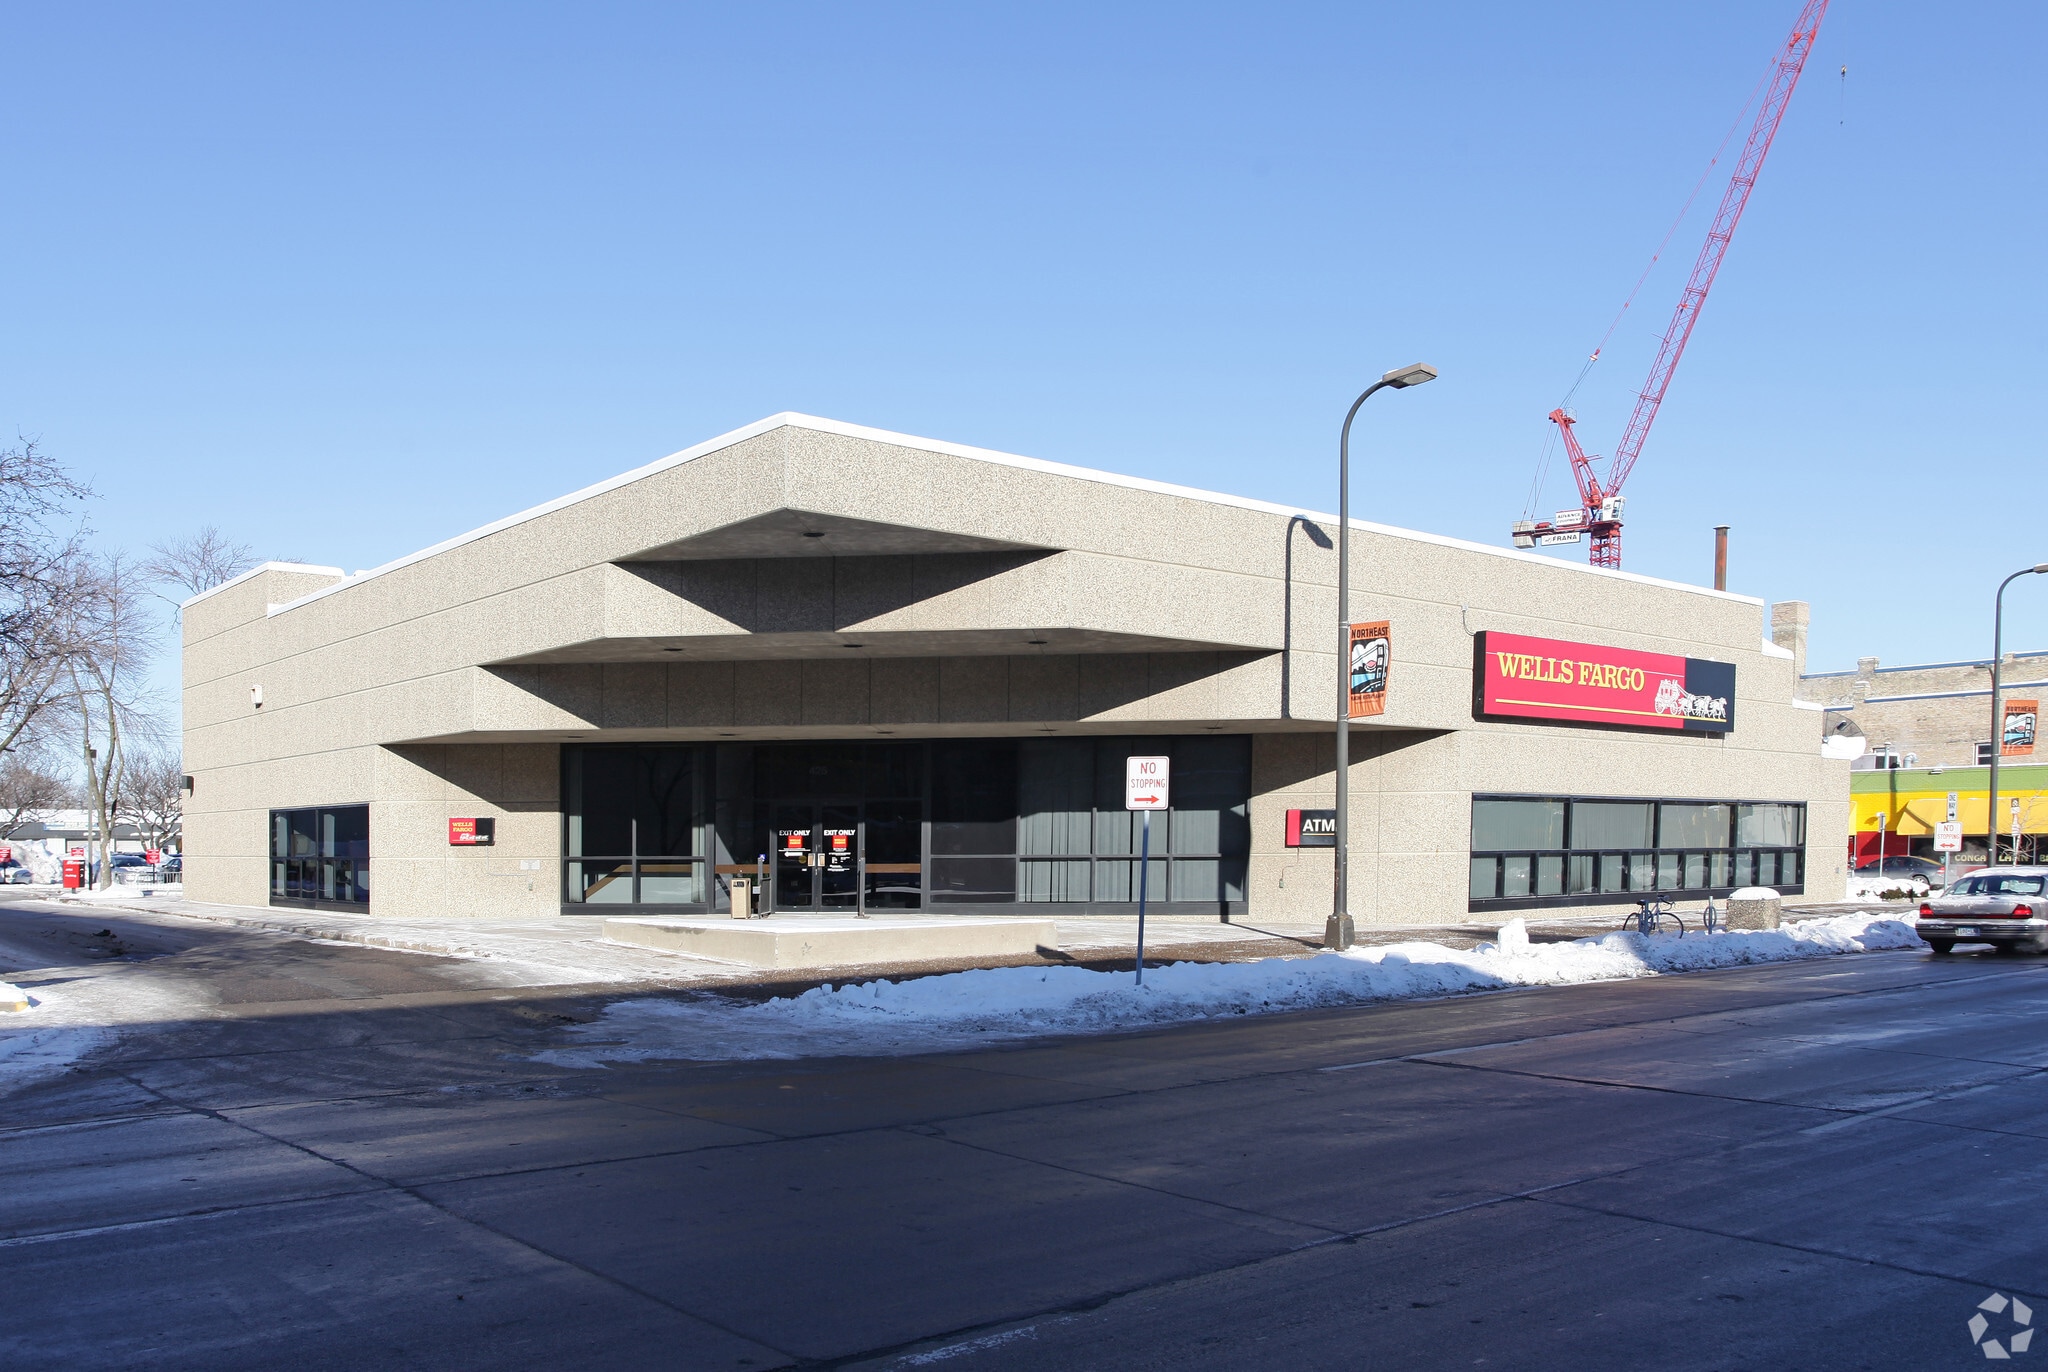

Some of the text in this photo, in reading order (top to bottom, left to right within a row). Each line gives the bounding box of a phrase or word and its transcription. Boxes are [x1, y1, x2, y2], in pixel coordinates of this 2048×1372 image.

[1552, 534, 1578, 542] FRANA
[1351, 626, 1389, 639] NORTHEAST
[1496, 651, 1645, 692] WELLS FARGO
[1140, 762, 1157, 775] NO
[1130, 778, 1166, 789] STOPPING
